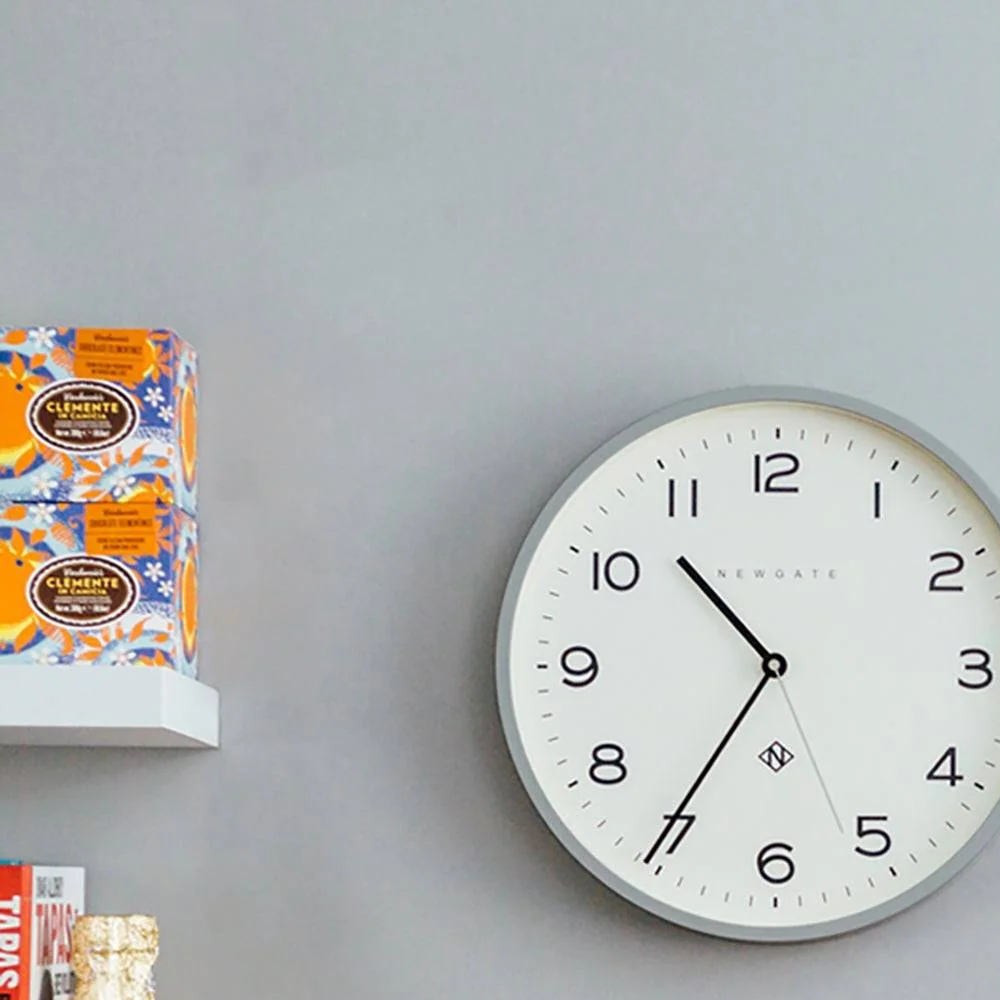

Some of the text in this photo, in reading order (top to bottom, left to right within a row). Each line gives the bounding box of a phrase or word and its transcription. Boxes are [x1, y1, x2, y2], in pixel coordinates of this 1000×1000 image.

[46, 401, 119, 413] CLEMENTE
[754, 452, 800, 493] 12
[668, 478, 698, 518] 11
[875, 481, 881, 518] 1
[46, 576, 119, 588] CLEMENTE
[592, 551, 641, 591] 10
[717, 568, 839, 580] NEWGATE
[929, 552, 964, 592] 2
[560, 645, 599, 687] 9
[957, 648, 993, 690] 3
[589, 743, 627, 785] 8
[926, 746, 964, 787] 4
[663, 814, 696, 854] 7
[855, 815, 891, 857] 5
[757, 843, 795, 884] 6
